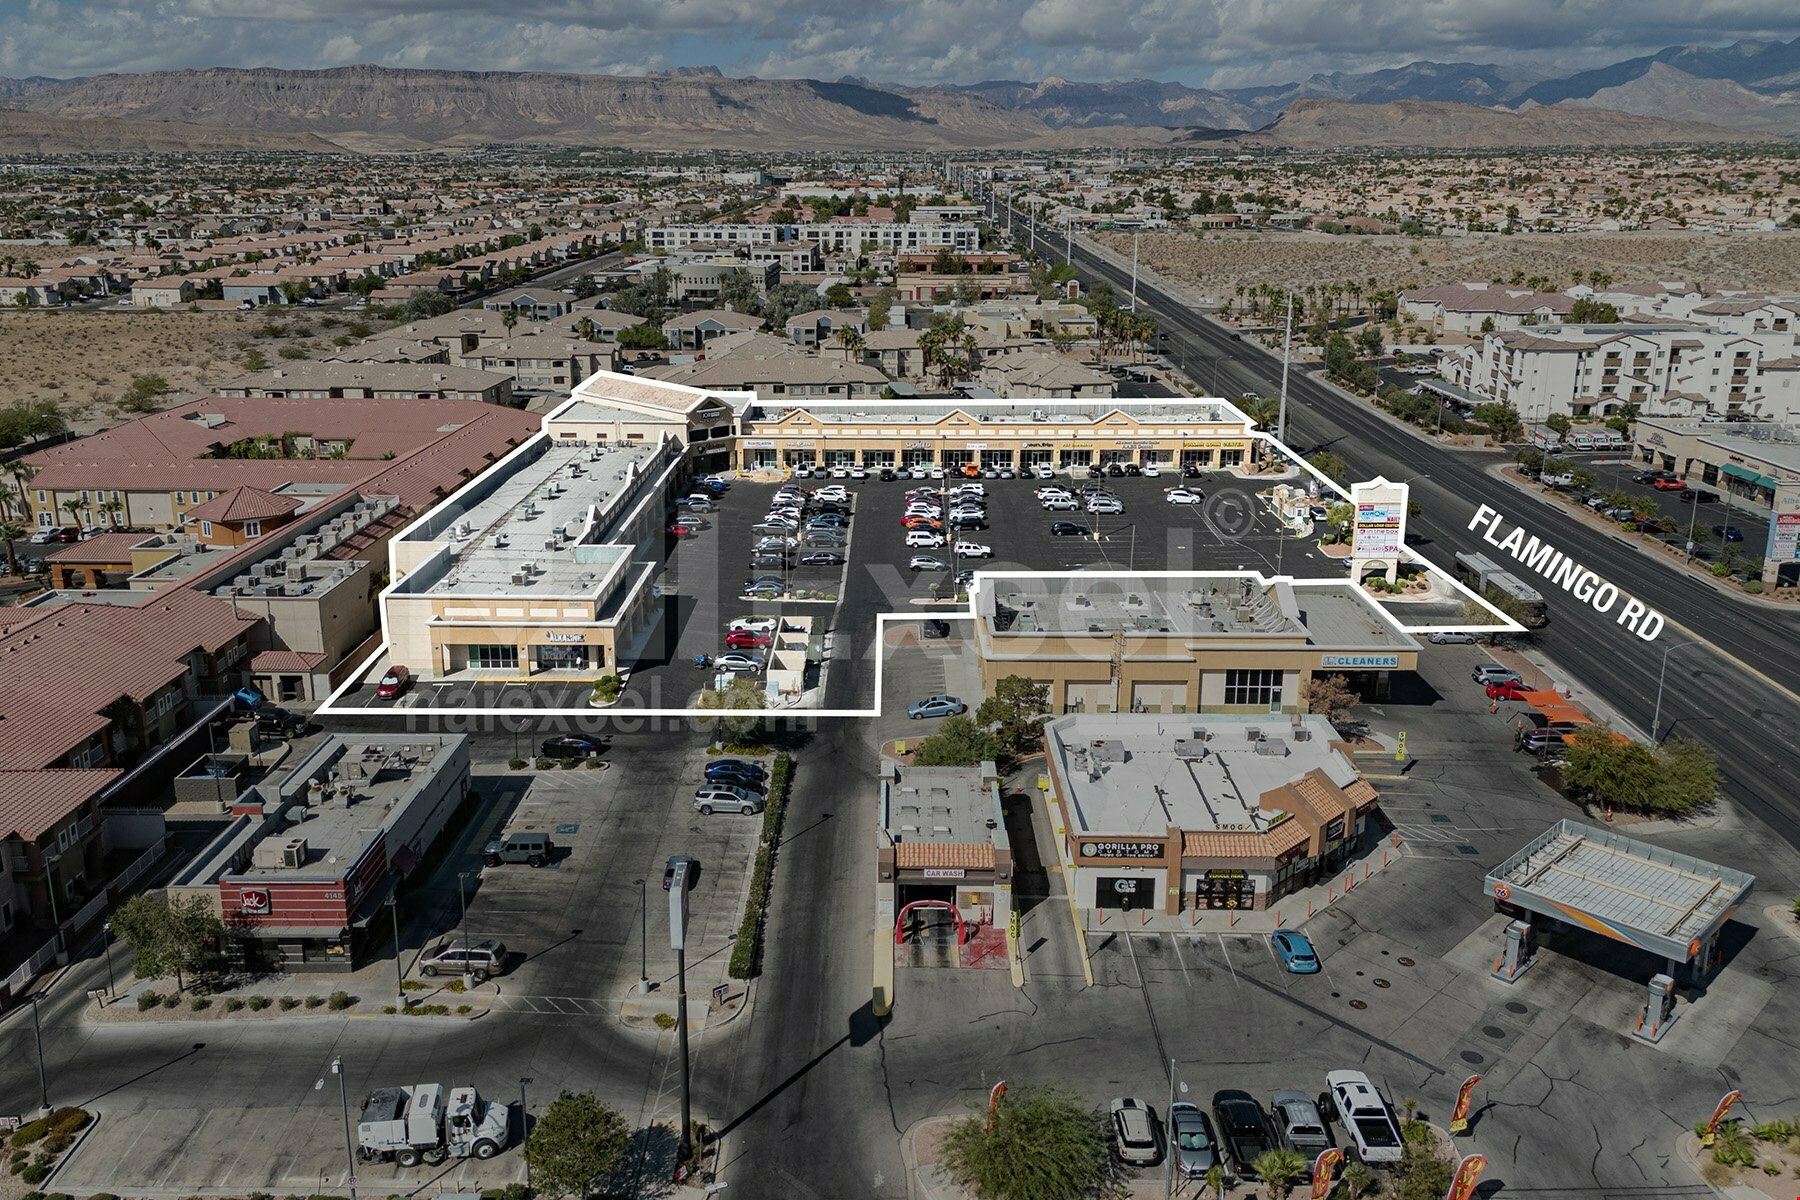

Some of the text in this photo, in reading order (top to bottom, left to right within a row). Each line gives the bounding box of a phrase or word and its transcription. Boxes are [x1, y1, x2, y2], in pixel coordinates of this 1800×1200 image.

[1337, 657, 1397, 666] CLEANERS
[1140, 843, 1159, 851] PRO
[324, 892, 343, 900] 4145
[1494, 887, 1508, 897] 76
[242, 893, 266, 908] Jack
